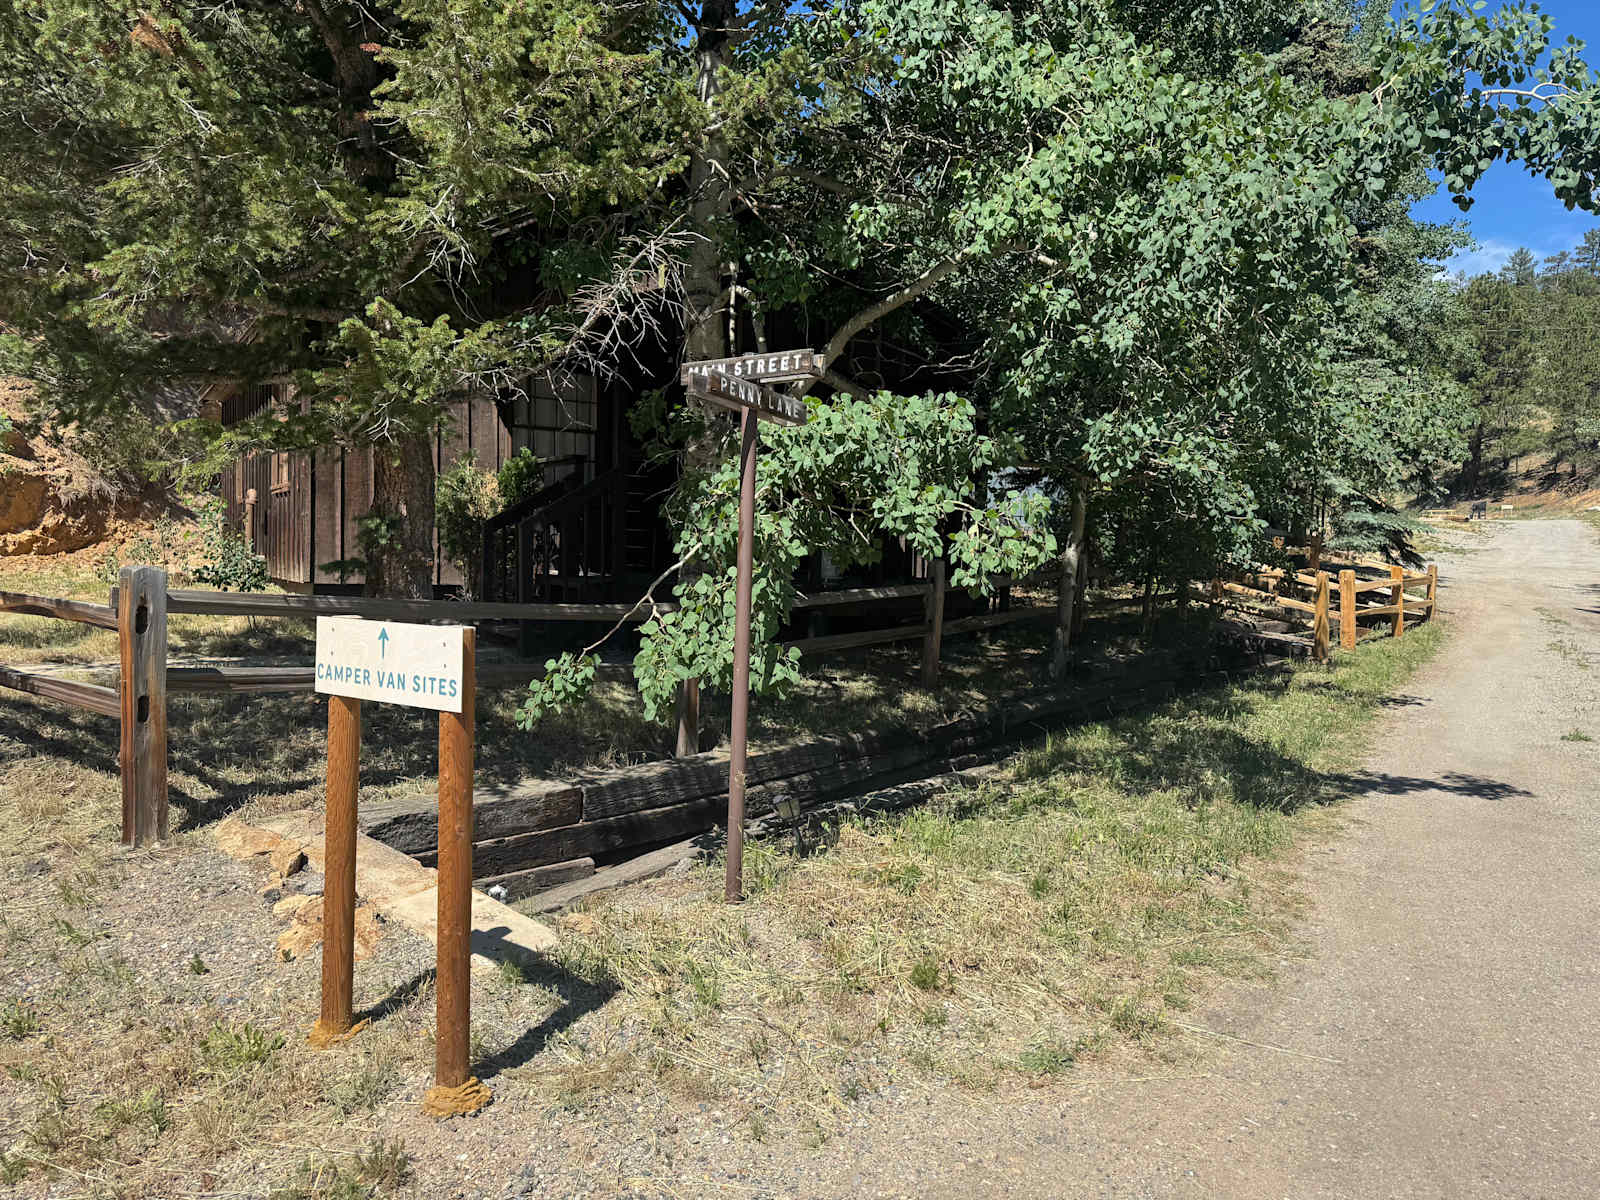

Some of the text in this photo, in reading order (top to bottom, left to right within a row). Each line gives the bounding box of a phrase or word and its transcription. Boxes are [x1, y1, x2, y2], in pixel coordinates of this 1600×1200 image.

[734, 355, 802, 376] STREET
[720, 377, 800, 418] PENNY LANE
[317, 663, 457, 697] CAMPER VAN SITES
